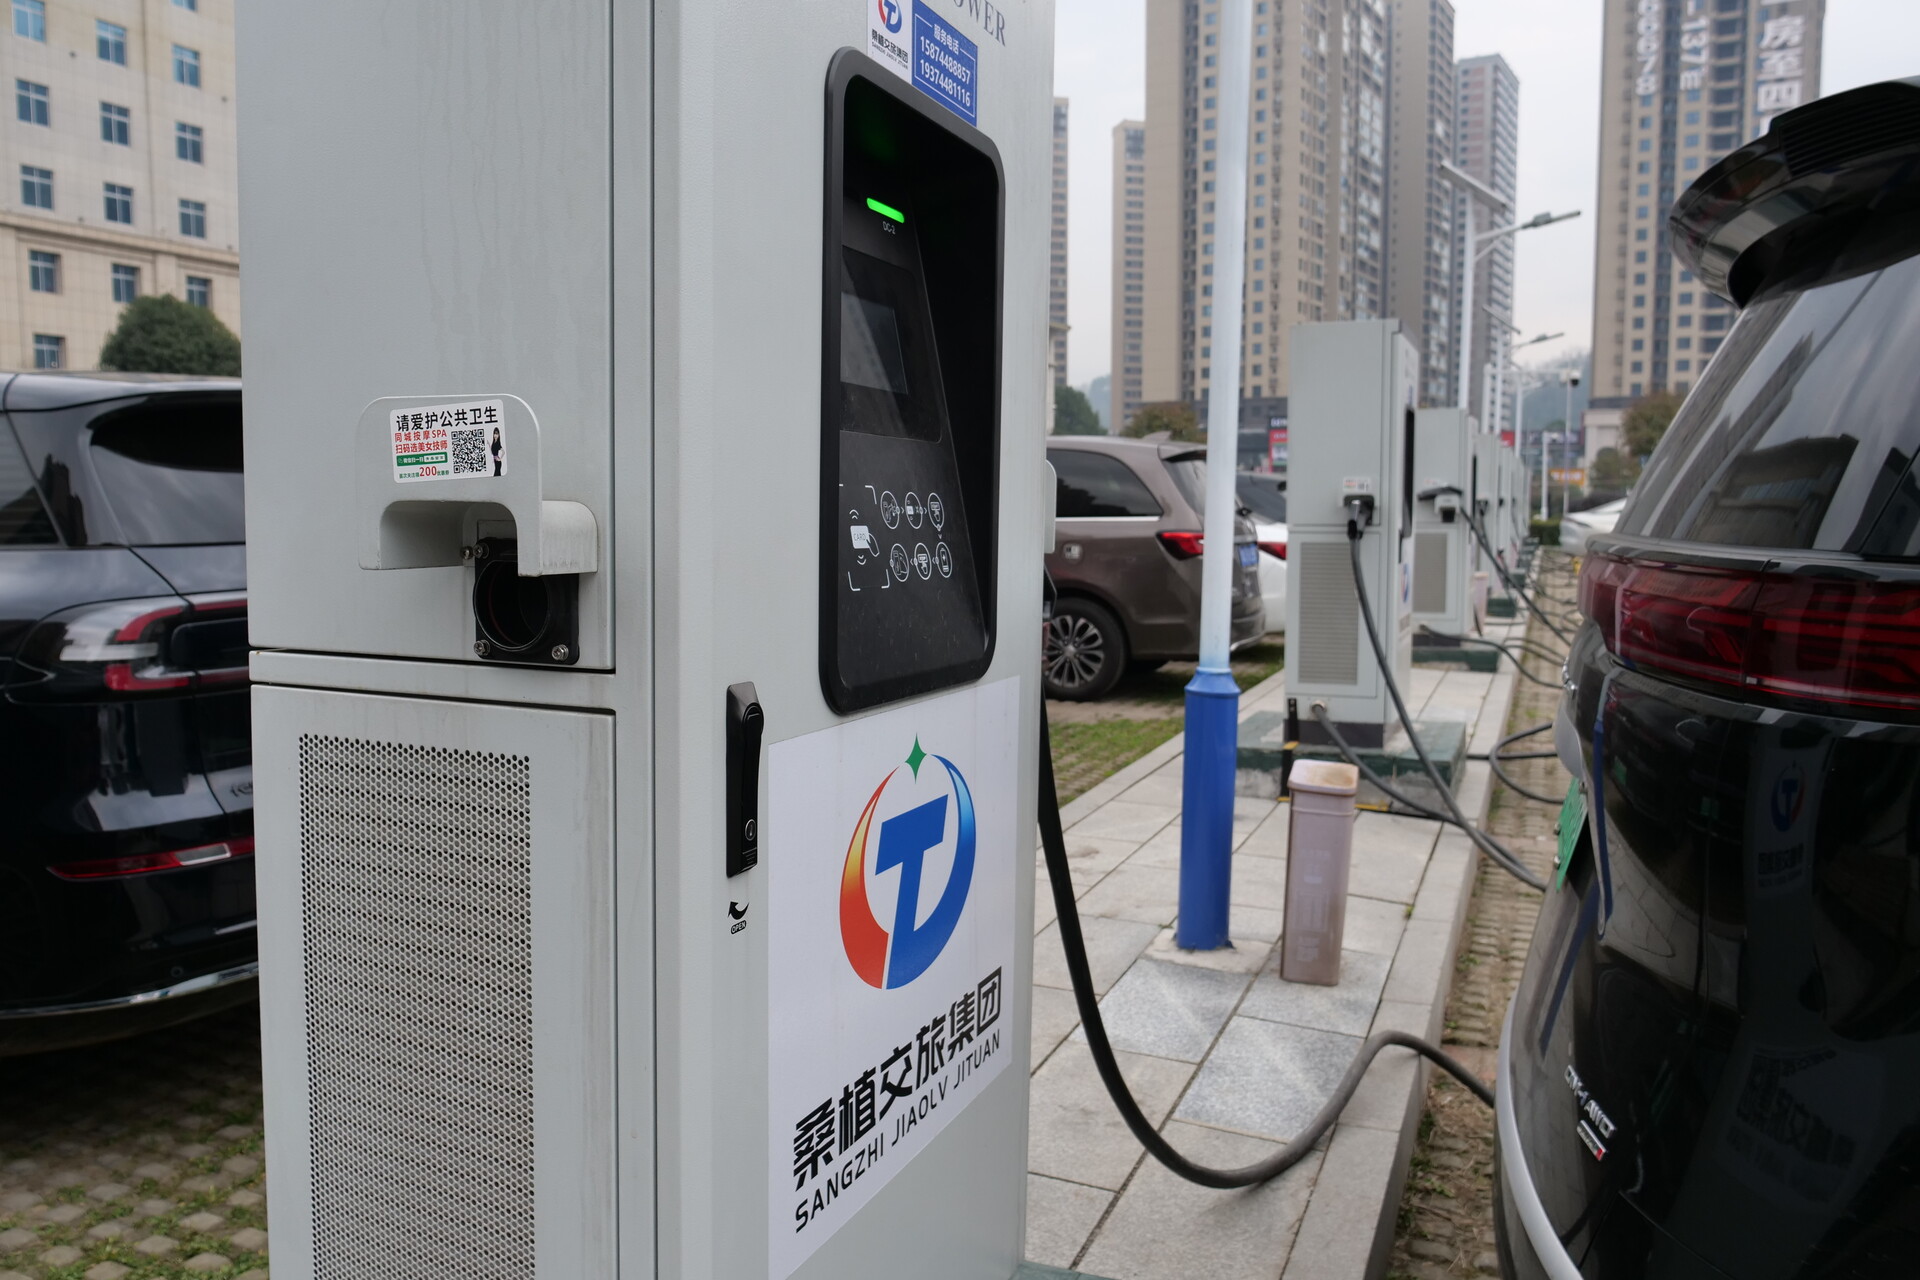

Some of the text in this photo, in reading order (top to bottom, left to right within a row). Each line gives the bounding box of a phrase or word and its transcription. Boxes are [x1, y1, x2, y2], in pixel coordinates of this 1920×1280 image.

[933, 23, 960, 56] 服务电话
[953, 0, 1005, 47] WER
[919, 36, 971, 85] 15874488857
[919, 59, 971, 107] 19374481116
[396, 405, 499, 432] 请爱护公共卫生
[395, 440, 449, 454] 扫码选美女技师
[731, 920, 747, 933] OPEN
[793, 965, 1002, 1192] 桑植交旅集团
[795, 1029, 1001, 1234] SANGZHI JIAOLV JITUAN
